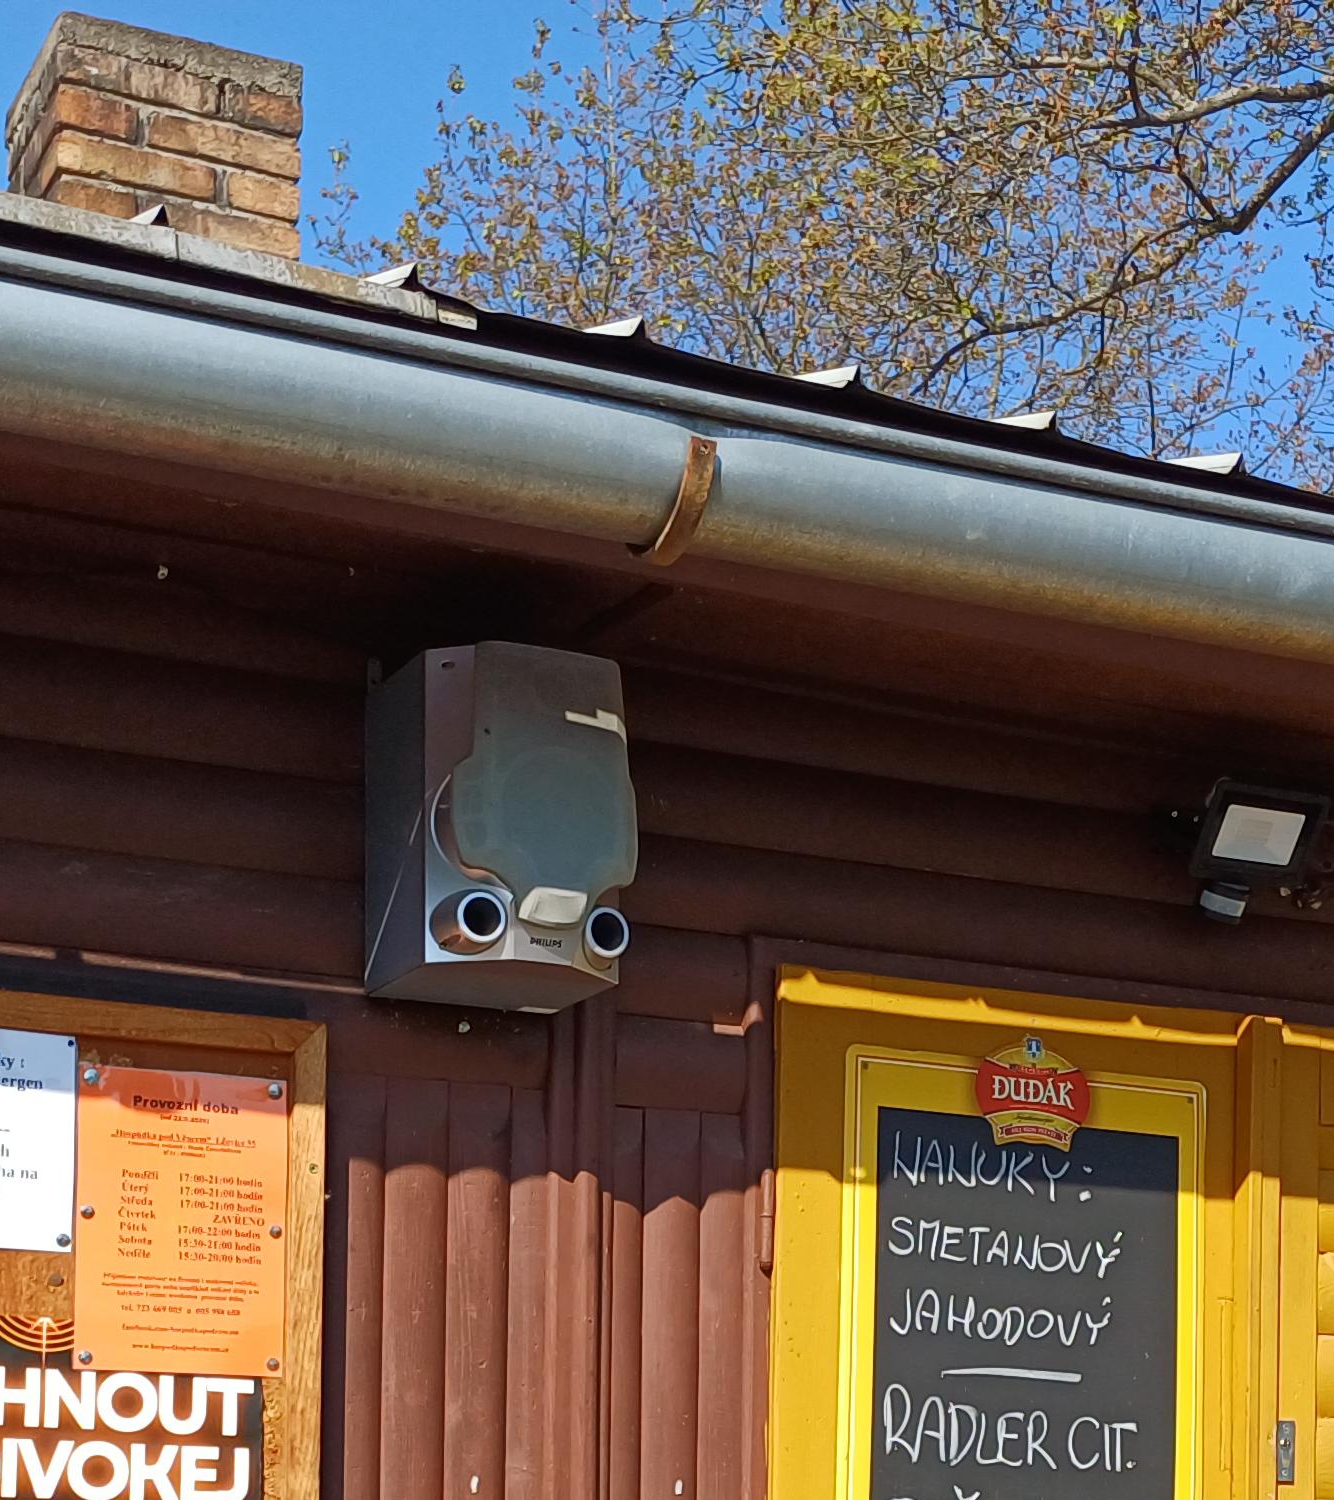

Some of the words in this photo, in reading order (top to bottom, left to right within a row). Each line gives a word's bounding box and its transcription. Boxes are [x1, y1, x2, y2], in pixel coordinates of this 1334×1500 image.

[530, 936, 562, 949] PHILIPS
[133, 1094, 198, 1112] Provozní
[203, 1101, 239, 1115] doba
[20, 1168, 38, 1180] na
[213, 1214, 265, 1226] ZAVŘENO
[119, 1222, 147, 1232] Pátek
[118, 1235, 152, 1245] Sobota
[888, 1216, 1122, 1279] SMETANOVÝ
[889, 1288, 1112, 1346] JAHODOVÝ
[883, 1383, 1057, 1470] RADLER
[1067, 1416, 1138, 1472] CIT.
